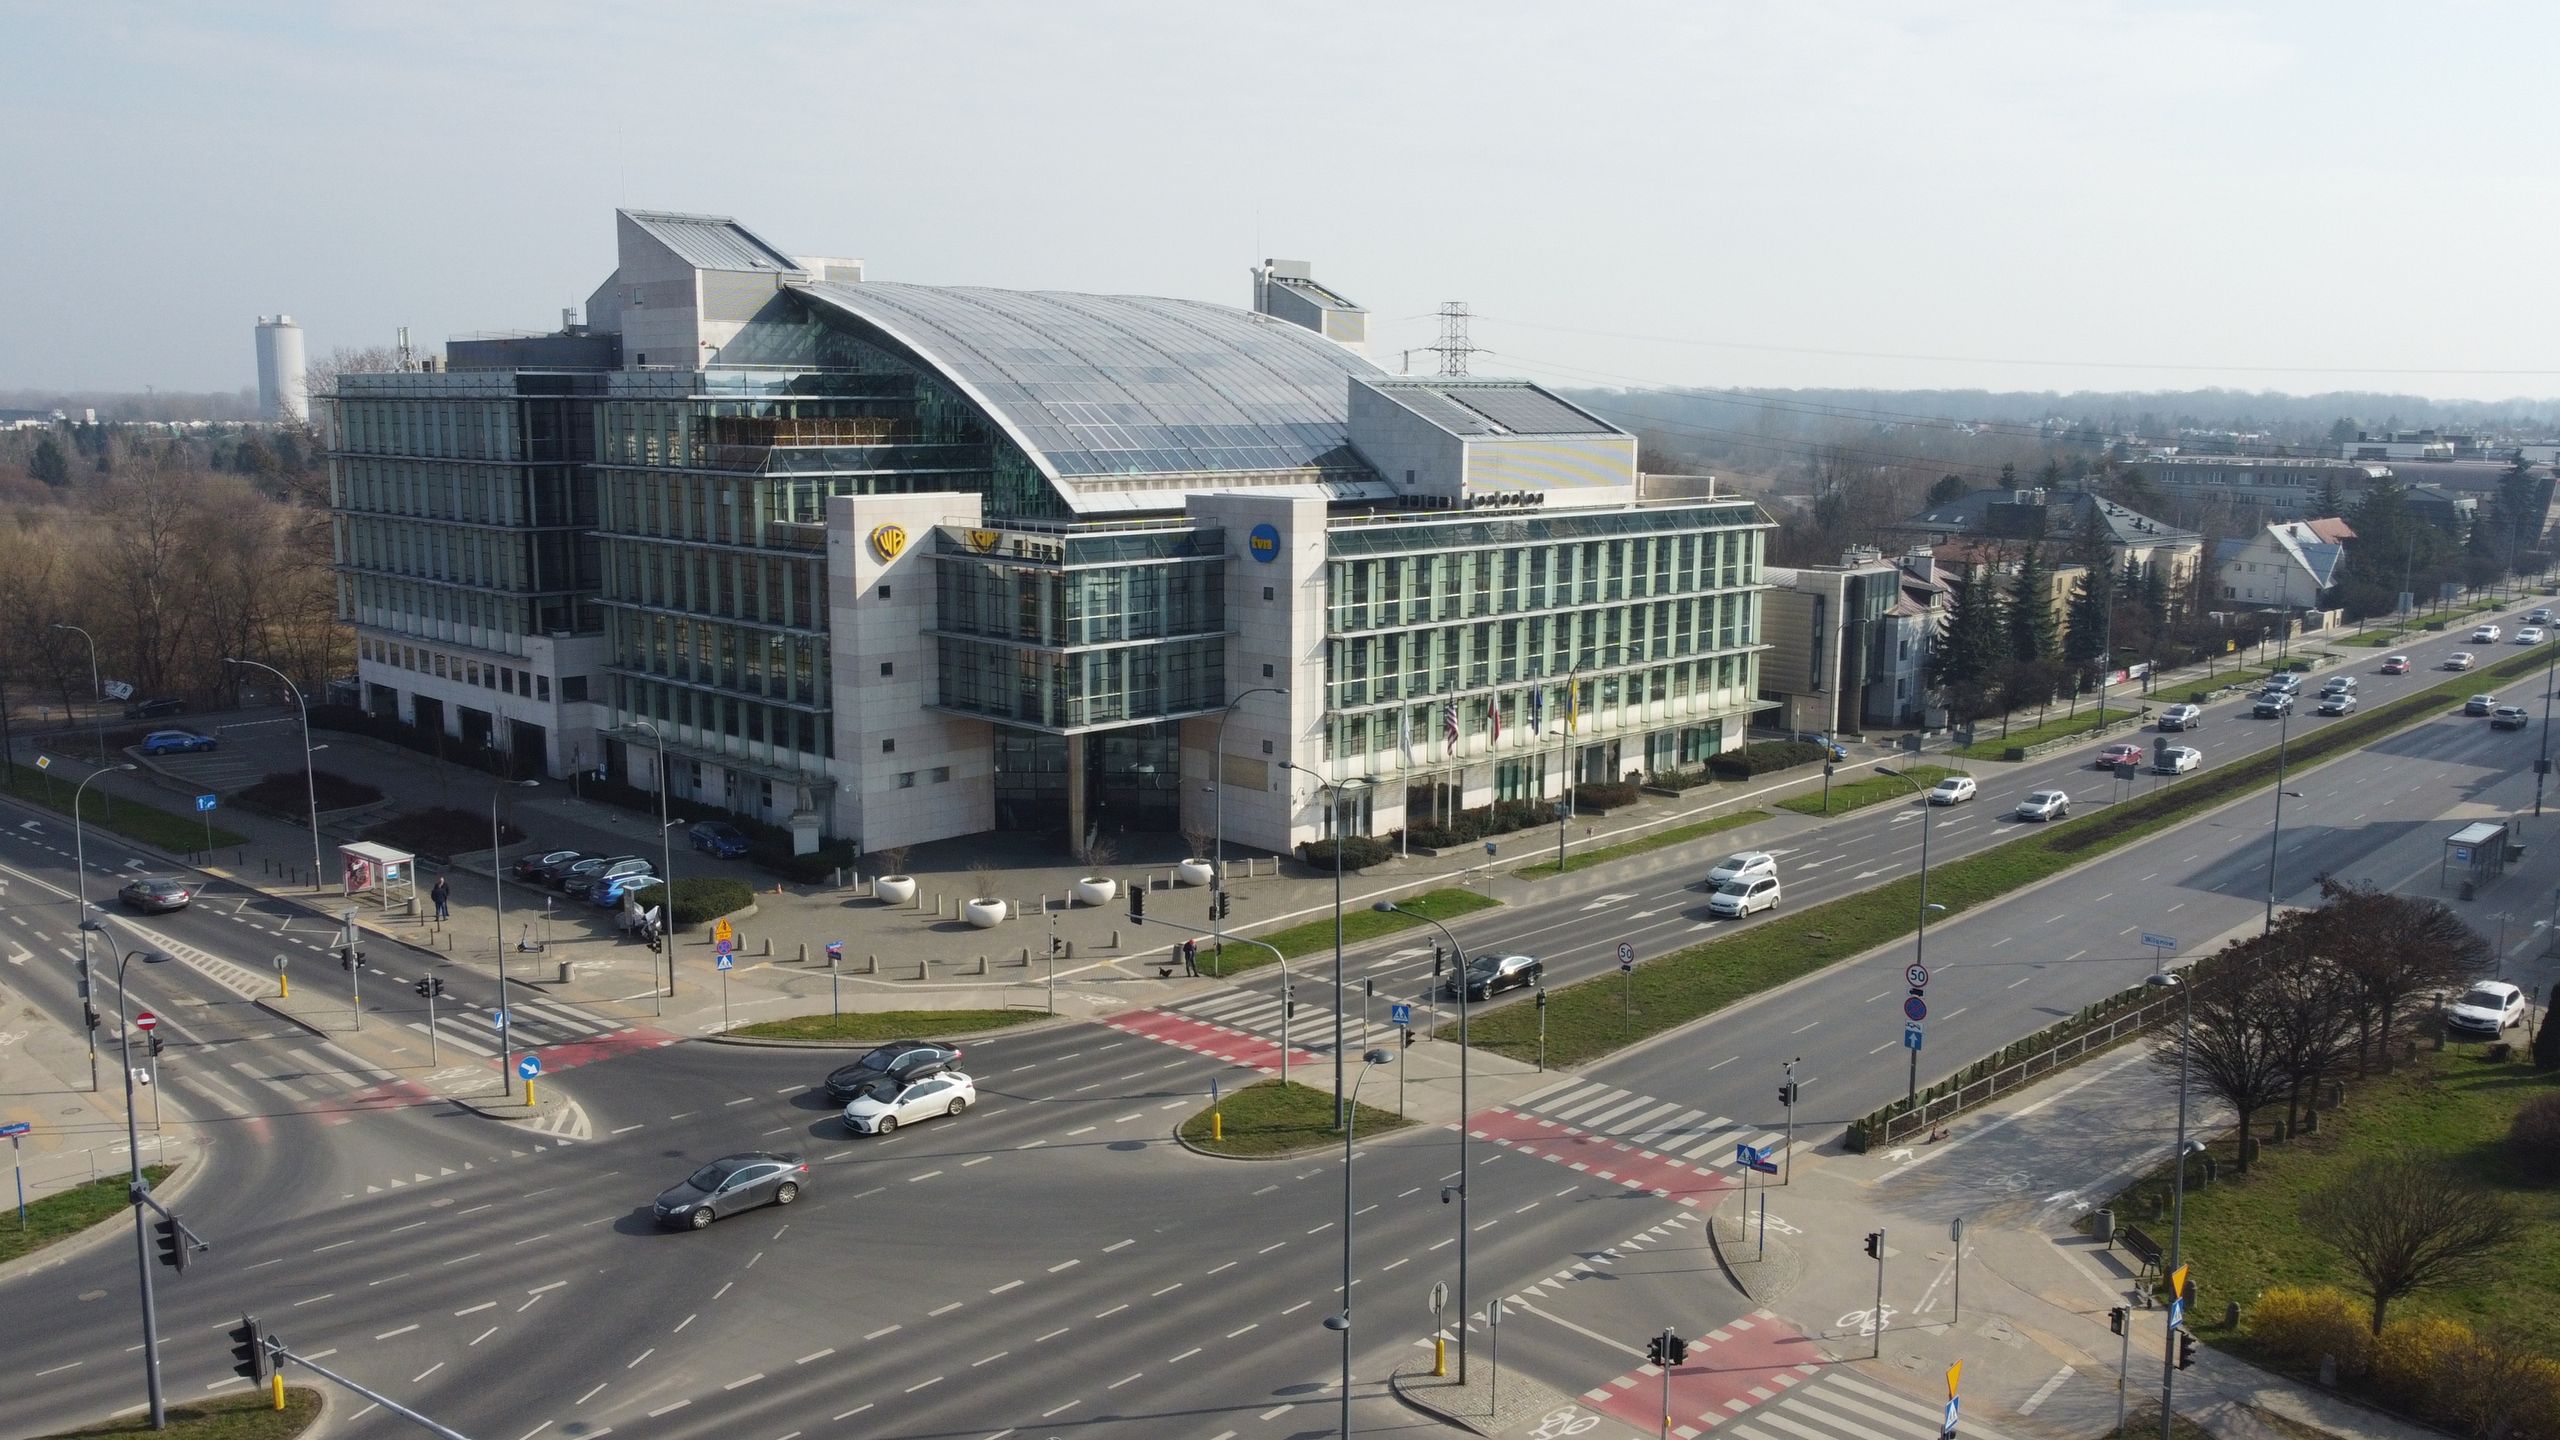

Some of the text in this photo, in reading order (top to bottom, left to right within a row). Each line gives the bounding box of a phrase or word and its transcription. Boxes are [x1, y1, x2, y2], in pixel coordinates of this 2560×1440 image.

[880, 528, 904, 555] WB
[1251, 535, 1273, 550] tvn
[1620, 947, 1632, 959] 50
[1910, 969, 1926, 982] 50
